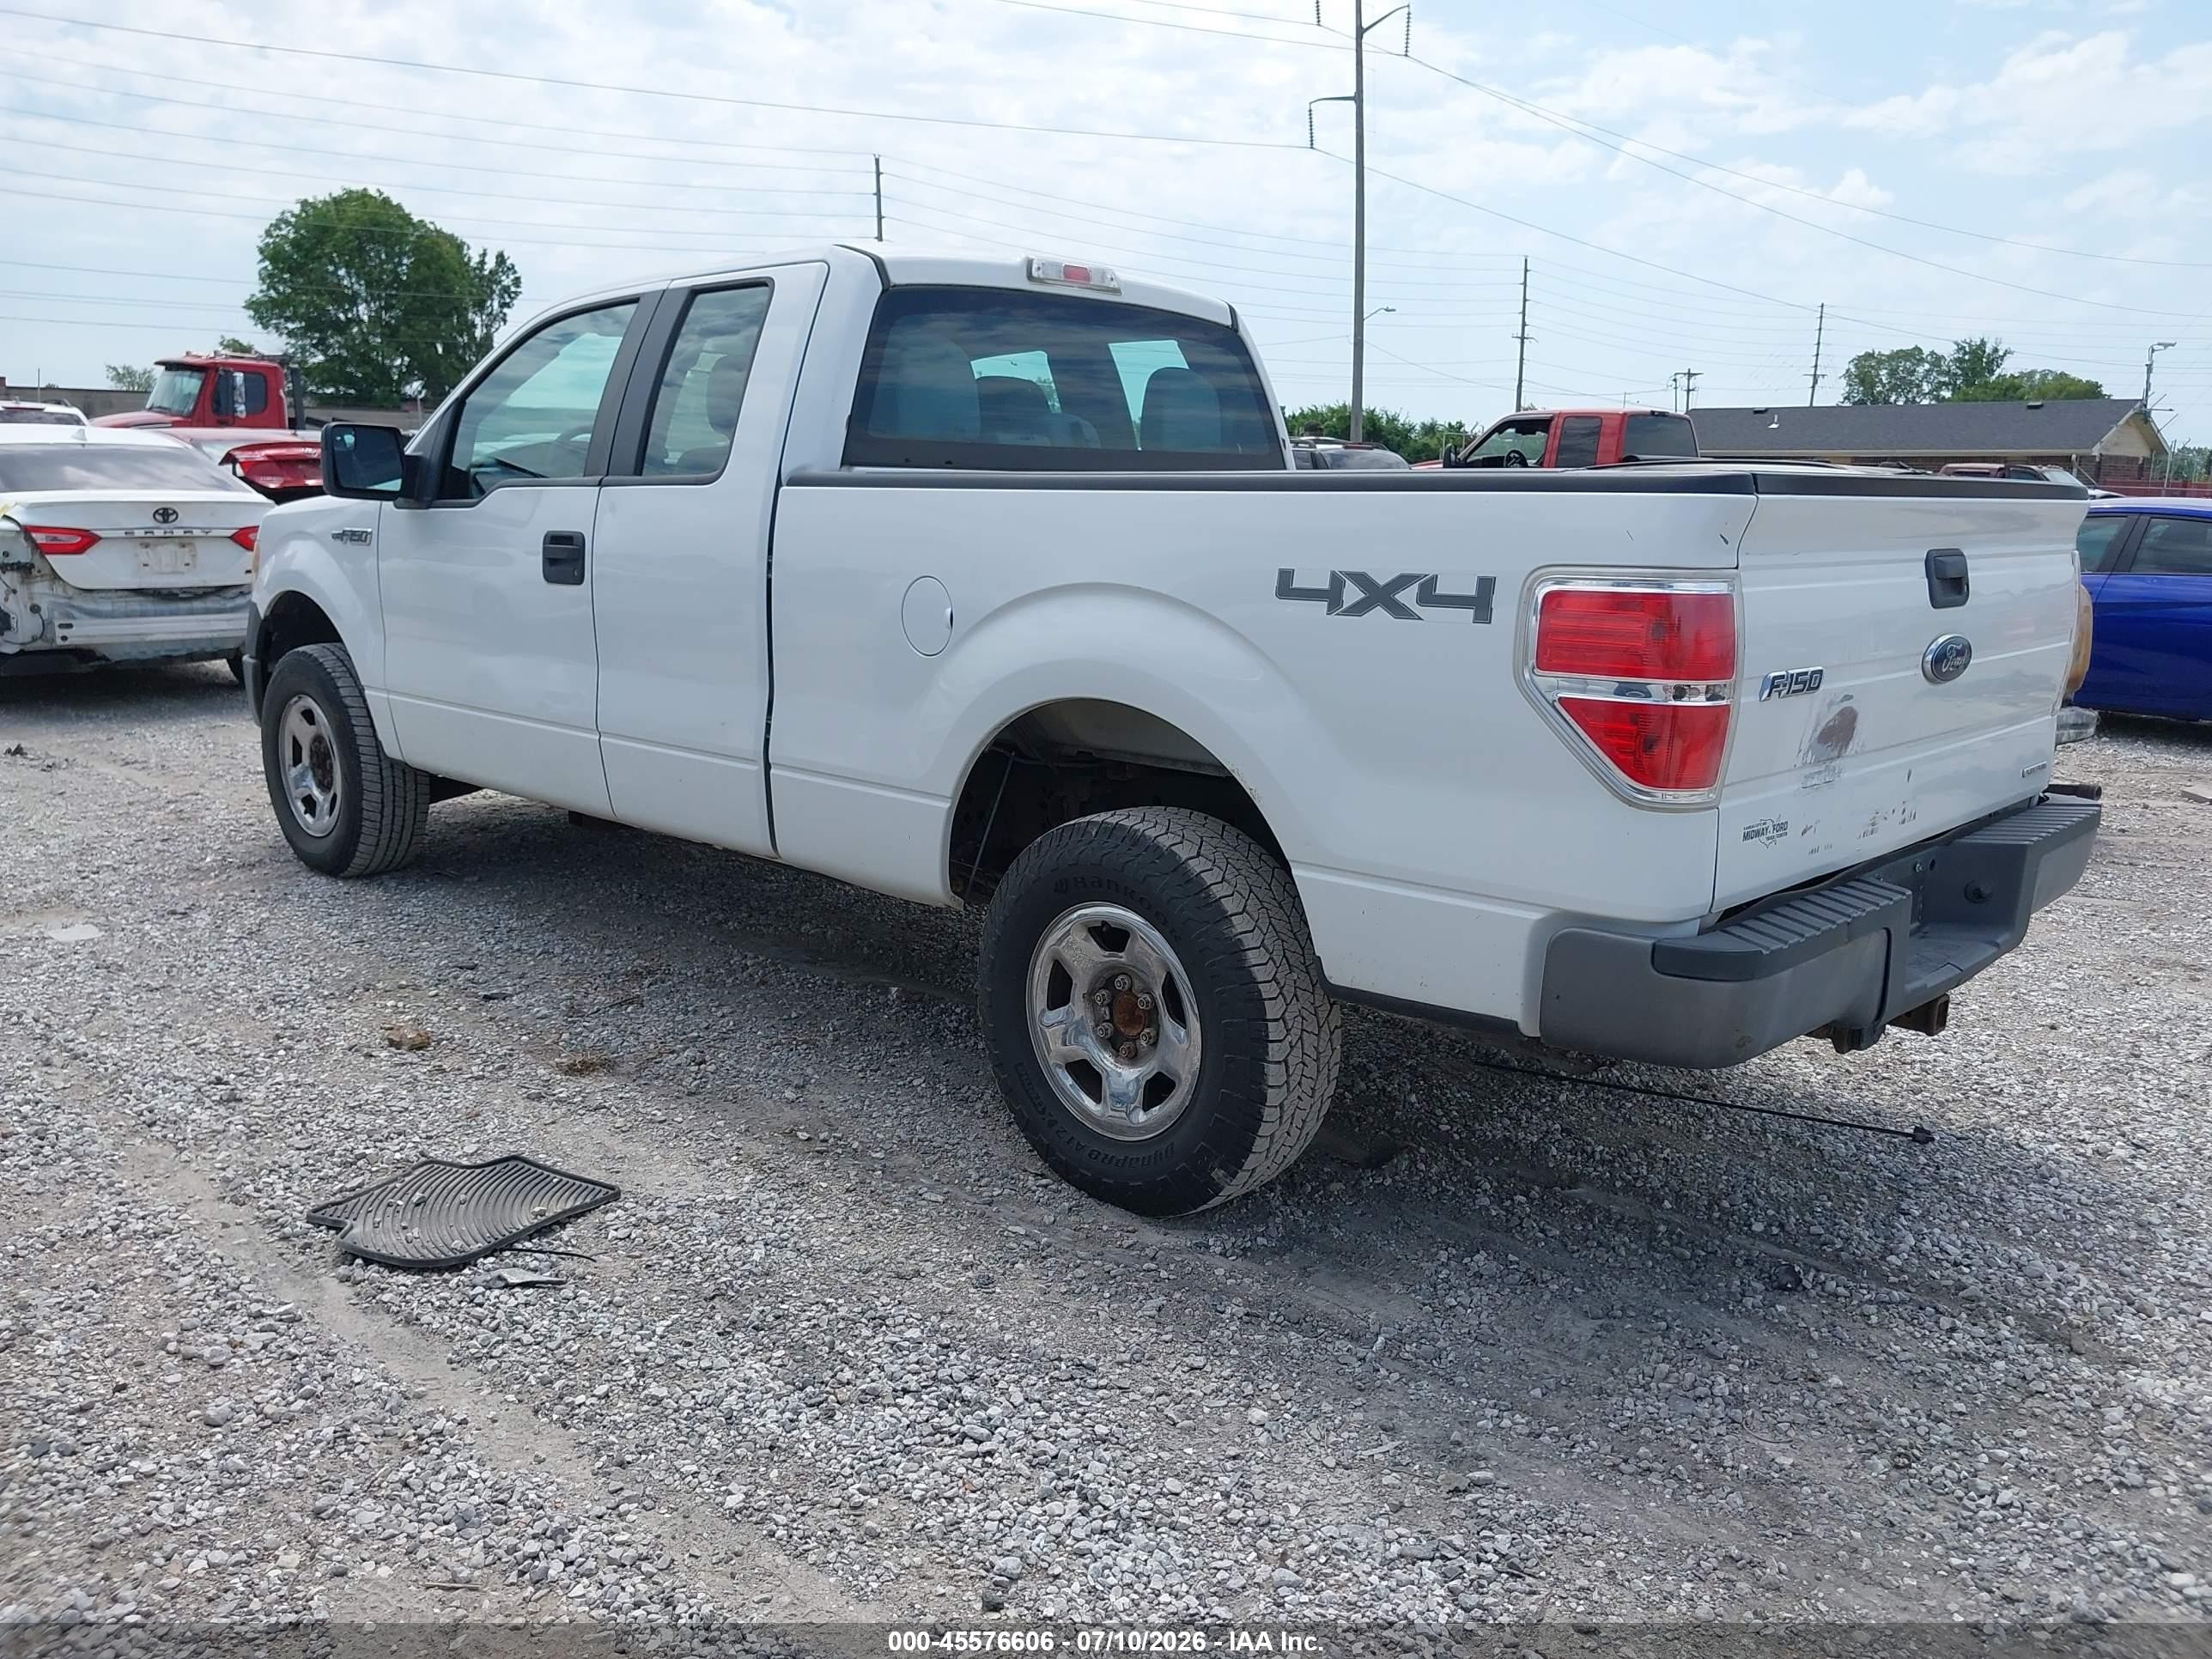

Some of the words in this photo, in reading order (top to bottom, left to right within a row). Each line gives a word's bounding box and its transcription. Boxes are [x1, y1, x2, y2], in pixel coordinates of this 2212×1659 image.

[1275, 568, 1497, 624] 4X4
[1759, 666, 1824, 702] F-150
[1742, 825, 1769, 842] MIDWAY
[1772, 821, 1788, 834] FORD
